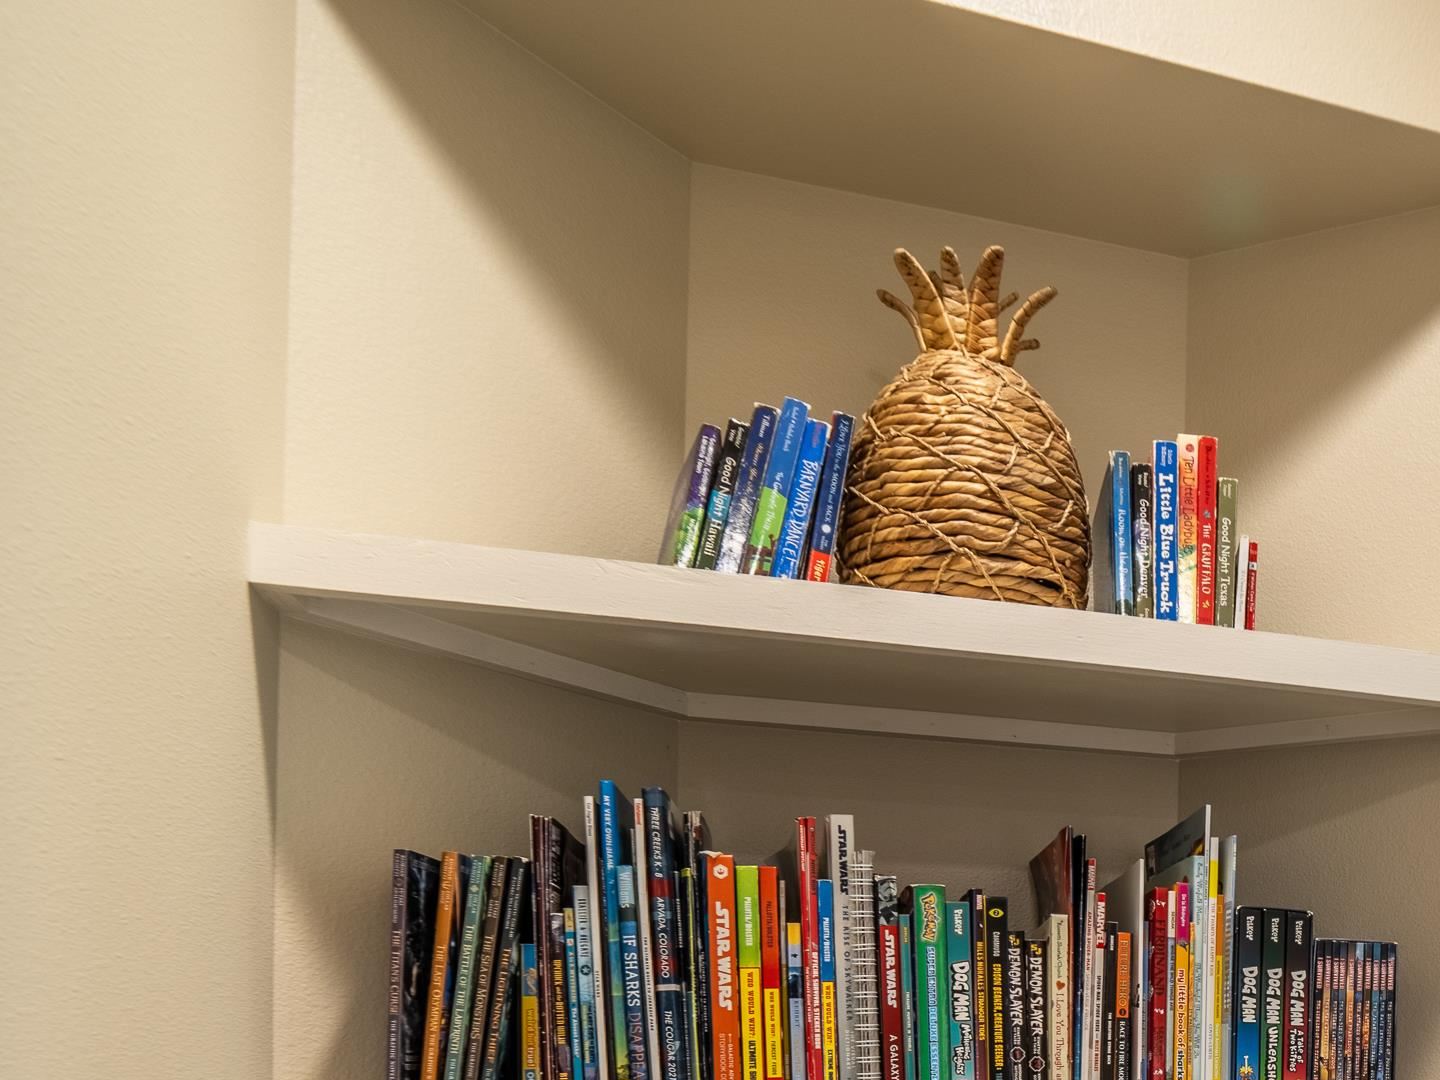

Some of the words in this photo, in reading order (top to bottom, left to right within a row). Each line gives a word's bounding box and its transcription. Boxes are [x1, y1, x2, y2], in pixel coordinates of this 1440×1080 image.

[721, 457, 736, 485] Good
[713, 486, 729, 516] Night
[792, 460, 818, 518] BARNYARD
[1159, 473, 1173, 519] Little
[1139, 499, 1150, 522] Good
[703, 519, 722, 556] Hawaii
[1138, 523, 1149, 556] Night
[1160, 524, 1173, 559] Blue
[1222, 517, 1231, 543] Good
[1201, 543, 1211, 594] GRUFFALO
[1220, 545, 1231, 575] Night
[1139, 560, 1149, 599] Denver
[1159, 560, 1174, 613] Truck
[1220, 576, 1230, 606] Texas
[652, 832, 661, 860] CREEKS
[838, 825, 846, 860] STAR
[839, 860, 848, 895] WARS
[715, 902, 730, 958] STAR
[1096, 901, 1105, 945] MARVEL
[622, 935, 637, 948] IF
[659, 933, 669, 978] COLORADO
[885, 929, 895, 967] STAR
[624, 953, 640, 1007] SHARKS
[717, 958, 732, 1011] WARS
[886, 968, 897, 1008] WARS
[1242, 966, 1258, 994] DOG
[1266, 968, 1282, 996] DOG
[1290, 970, 1306, 997] DOG
[489, 970, 510, 1030] LIGHTNING
[1178, 986, 1186, 1009] little
[1241, 996, 1257, 1022] MAN
[1266, 998, 1281, 1023] MAN
[1290, 1000, 1305, 1026] MAN
[471, 988, 487, 1040] MONSTERS
[664, 1010, 673, 1025] THE
[666, 1026, 675, 1061] COUGAR
[748, 1041, 756, 1069] ULTIMATE
[1055, 1038, 1065, 1070] Through
[1177, 1038, 1185, 1048] of
[667, 1063, 677, 1080] 2021
[890, 1045, 899, 1080] GALAXY
[1177, 1050, 1185, 1080] sharks
